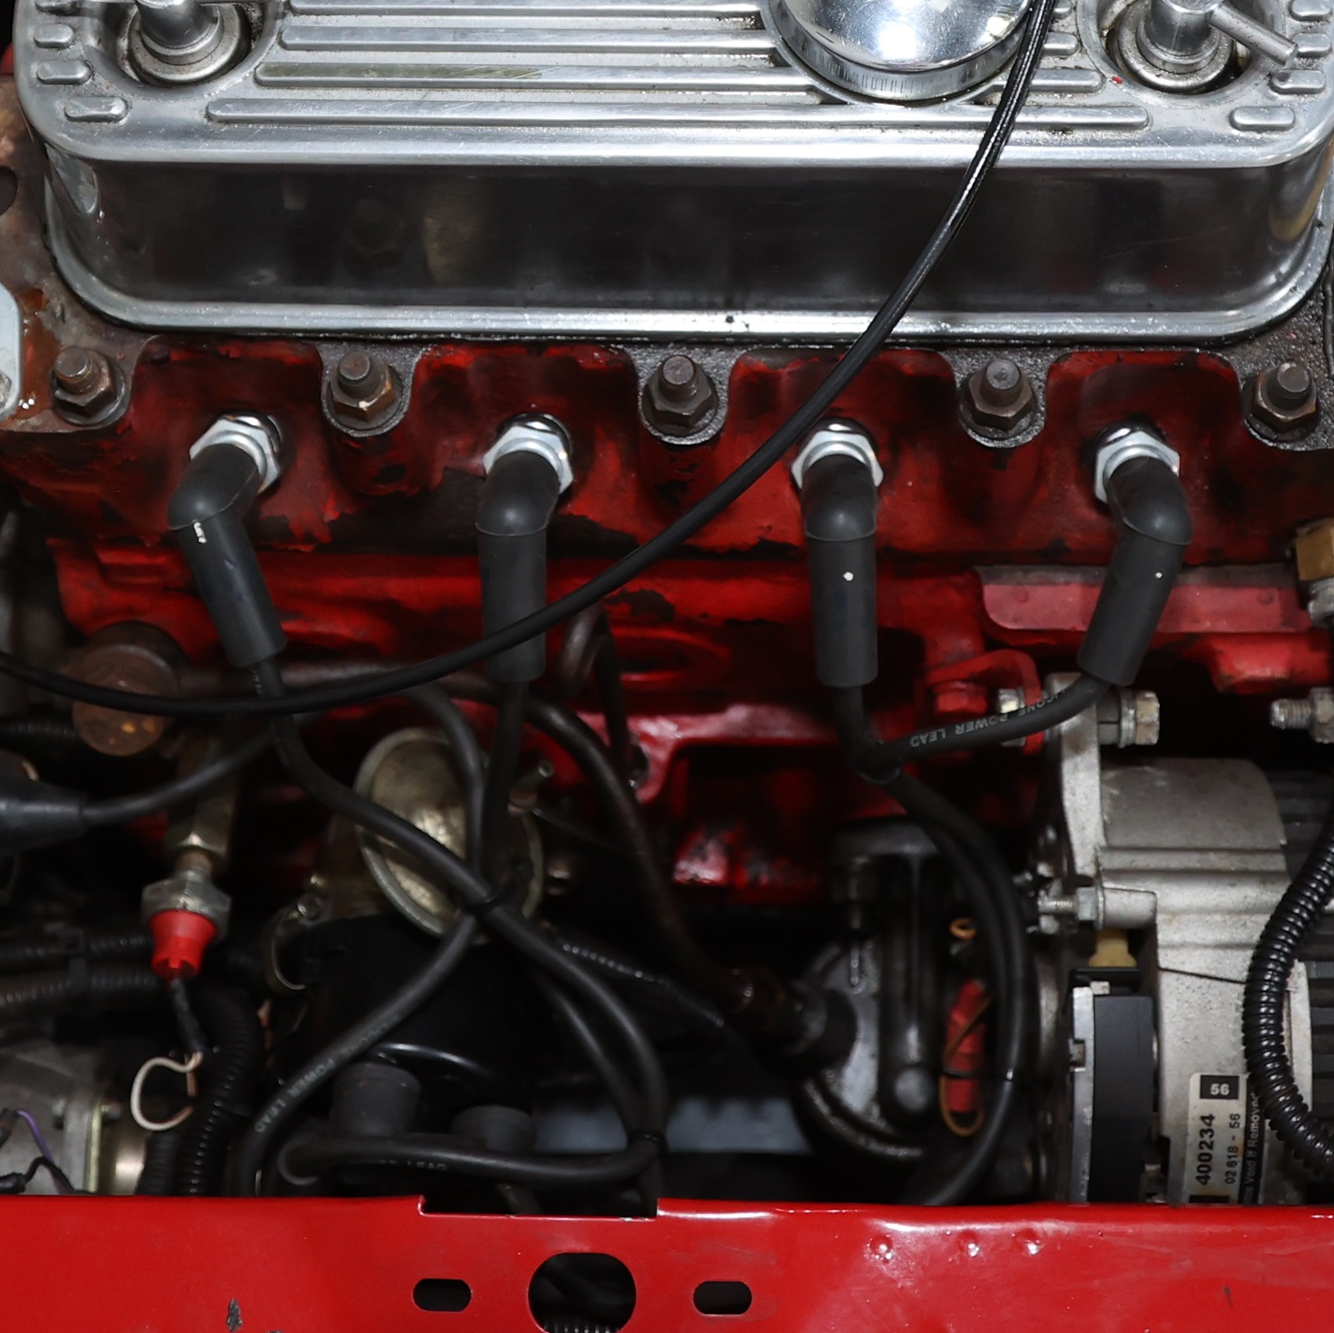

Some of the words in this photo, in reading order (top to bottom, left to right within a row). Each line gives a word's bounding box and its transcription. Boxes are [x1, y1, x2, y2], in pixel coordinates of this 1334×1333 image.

[909, 728, 947, 748] LEAD
[1210, 1083, 1230, 1096] 56
[254, 1099, 287, 1133] LEAD
[1196, 1113, 1216, 1186] 400234
